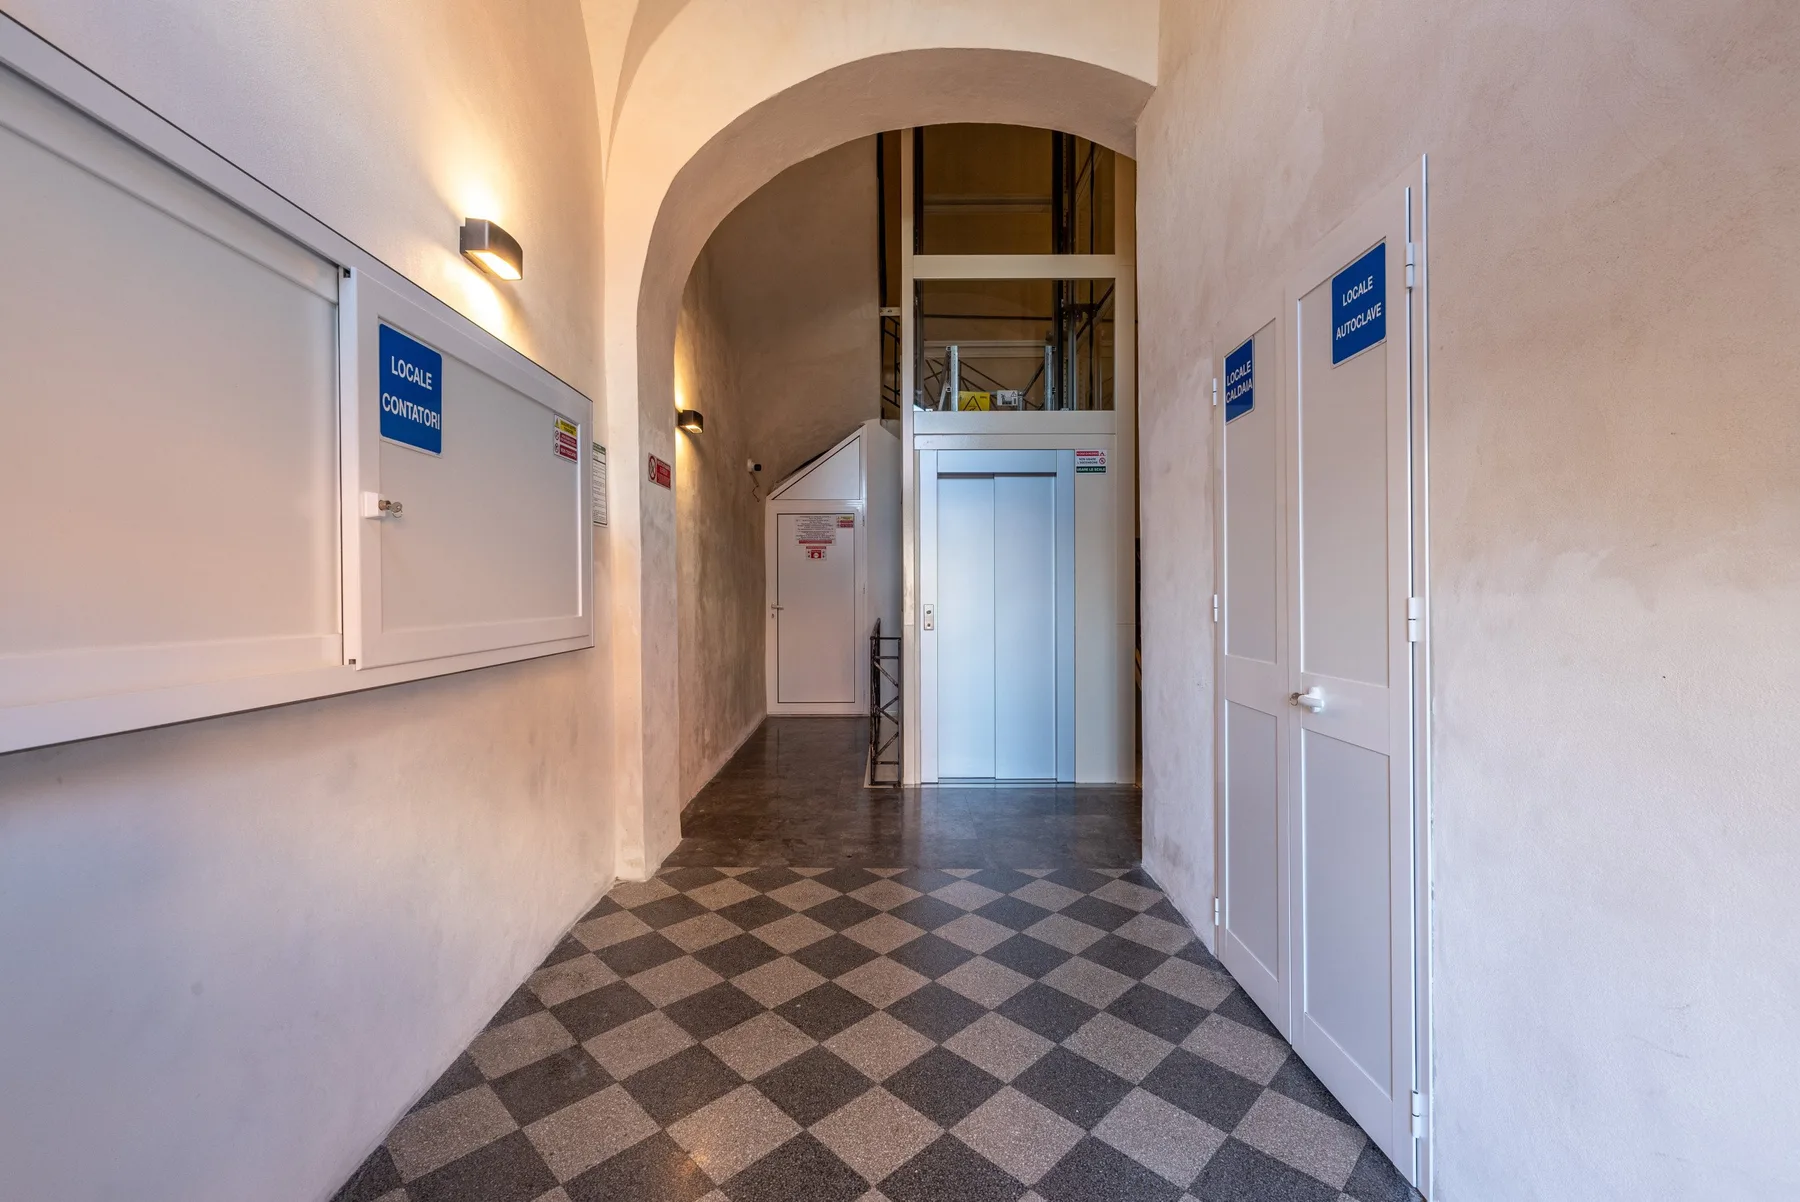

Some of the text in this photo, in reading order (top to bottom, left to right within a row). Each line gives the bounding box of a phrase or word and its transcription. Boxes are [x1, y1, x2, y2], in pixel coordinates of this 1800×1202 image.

[1342, 275, 1373, 307] LOCALE
[1335, 302, 1382, 341] AUTOCLAVE
[391, 355, 432, 391] LOCALE
[1226, 360, 1251, 387] LOCALE
[1225, 378, 1253, 404] CALDAIA
[382, 392, 441, 430] CONTATORI
